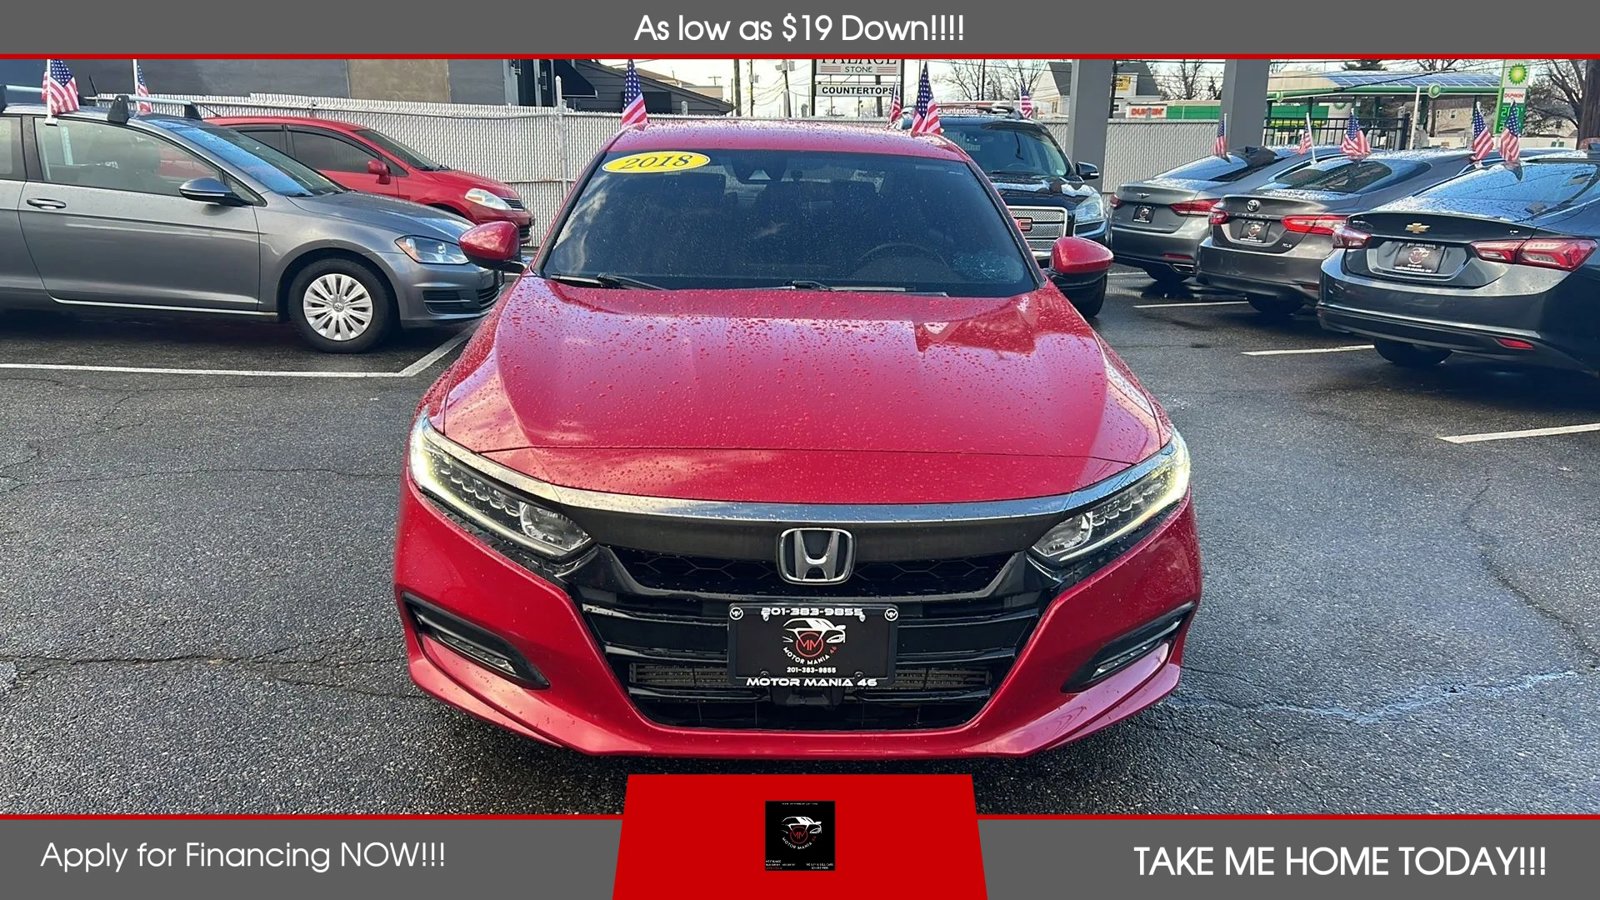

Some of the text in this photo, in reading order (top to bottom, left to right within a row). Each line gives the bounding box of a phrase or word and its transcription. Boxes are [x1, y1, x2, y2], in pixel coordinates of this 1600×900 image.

[822, 86, 893, 95] COUNTERTOPS
[619, 154, 692, 170] 2018
[760, 607, 863, 616] 201-383-9855
[782, 646, 805, 665] MOTOR
[806, 654, 830, 665] MANIA
[746, 678, 878, 687] MOTOR MANIA 46
